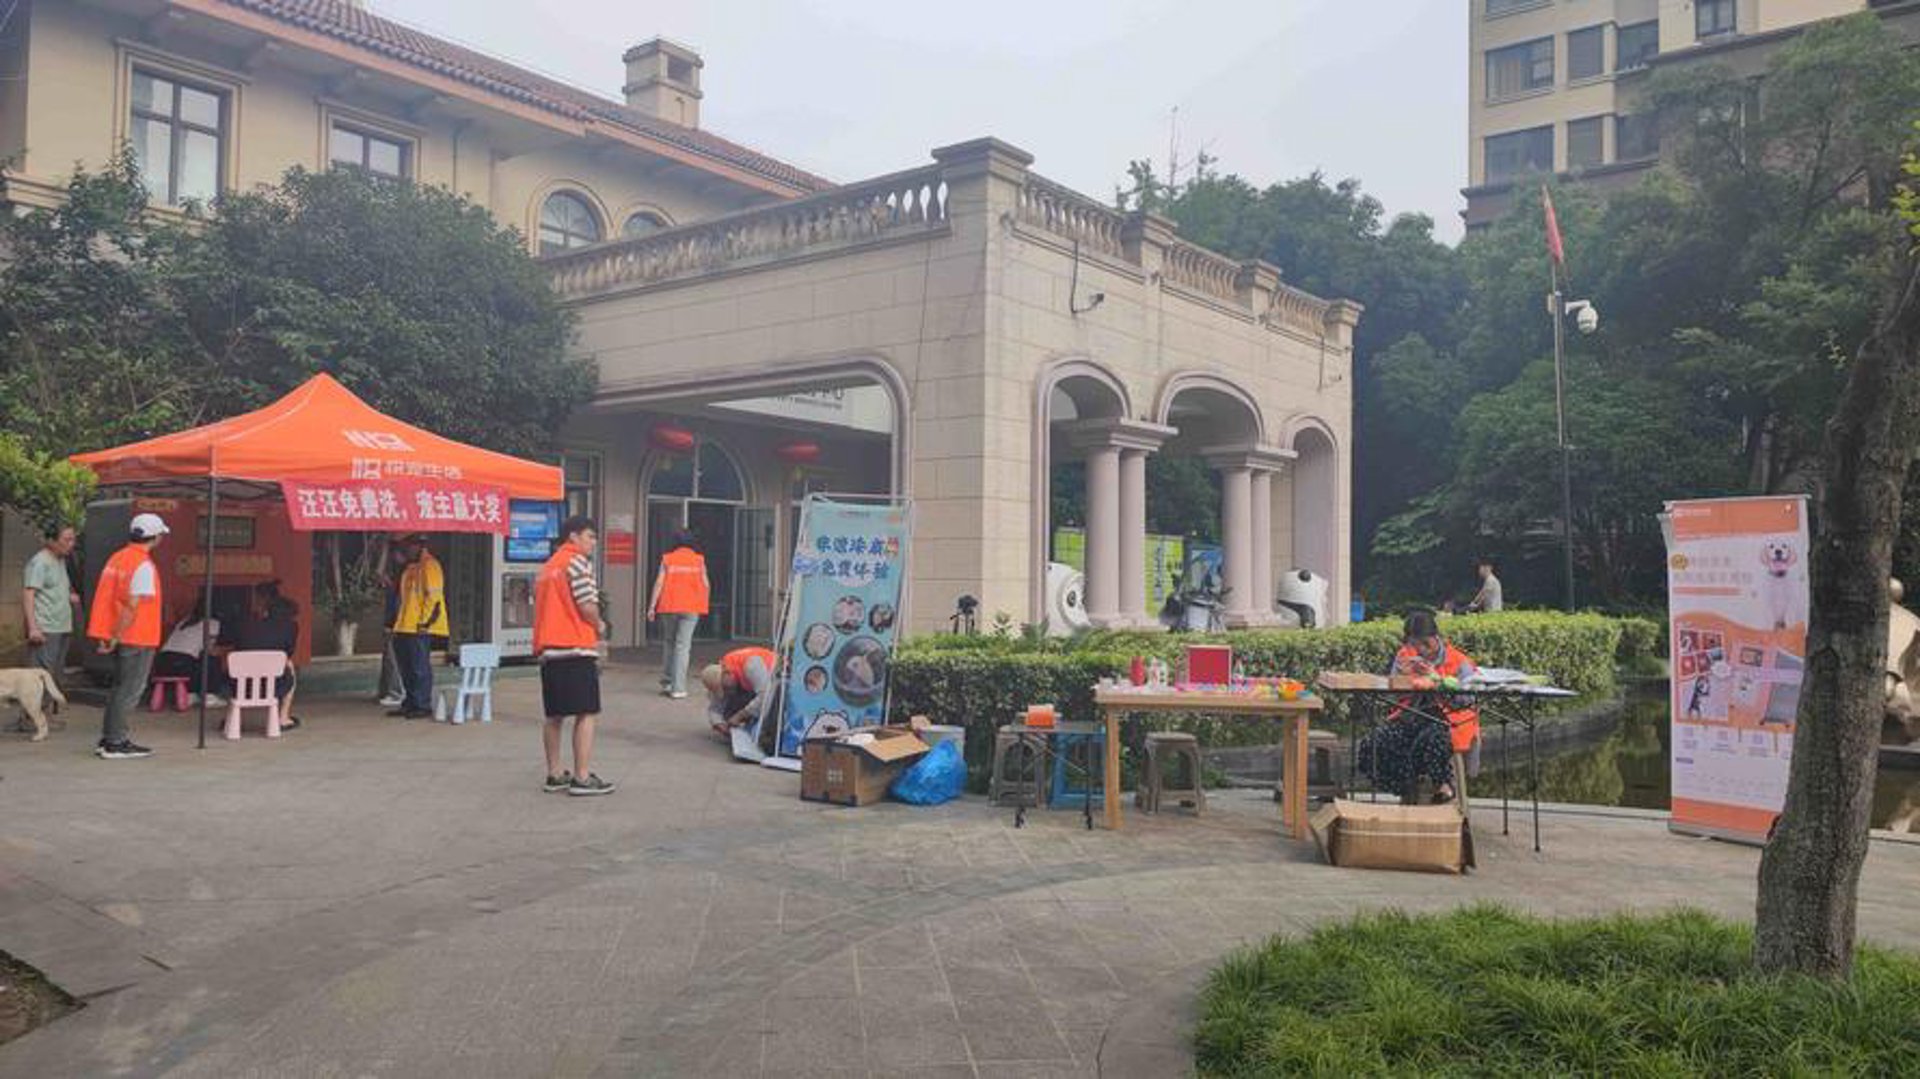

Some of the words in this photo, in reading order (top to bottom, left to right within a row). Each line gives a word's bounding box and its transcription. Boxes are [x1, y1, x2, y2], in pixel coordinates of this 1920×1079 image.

[297, 487, 502, 524] 汪汪免费洗，宠主赢大奖
[821, 558, 890, 580] 免费体验
